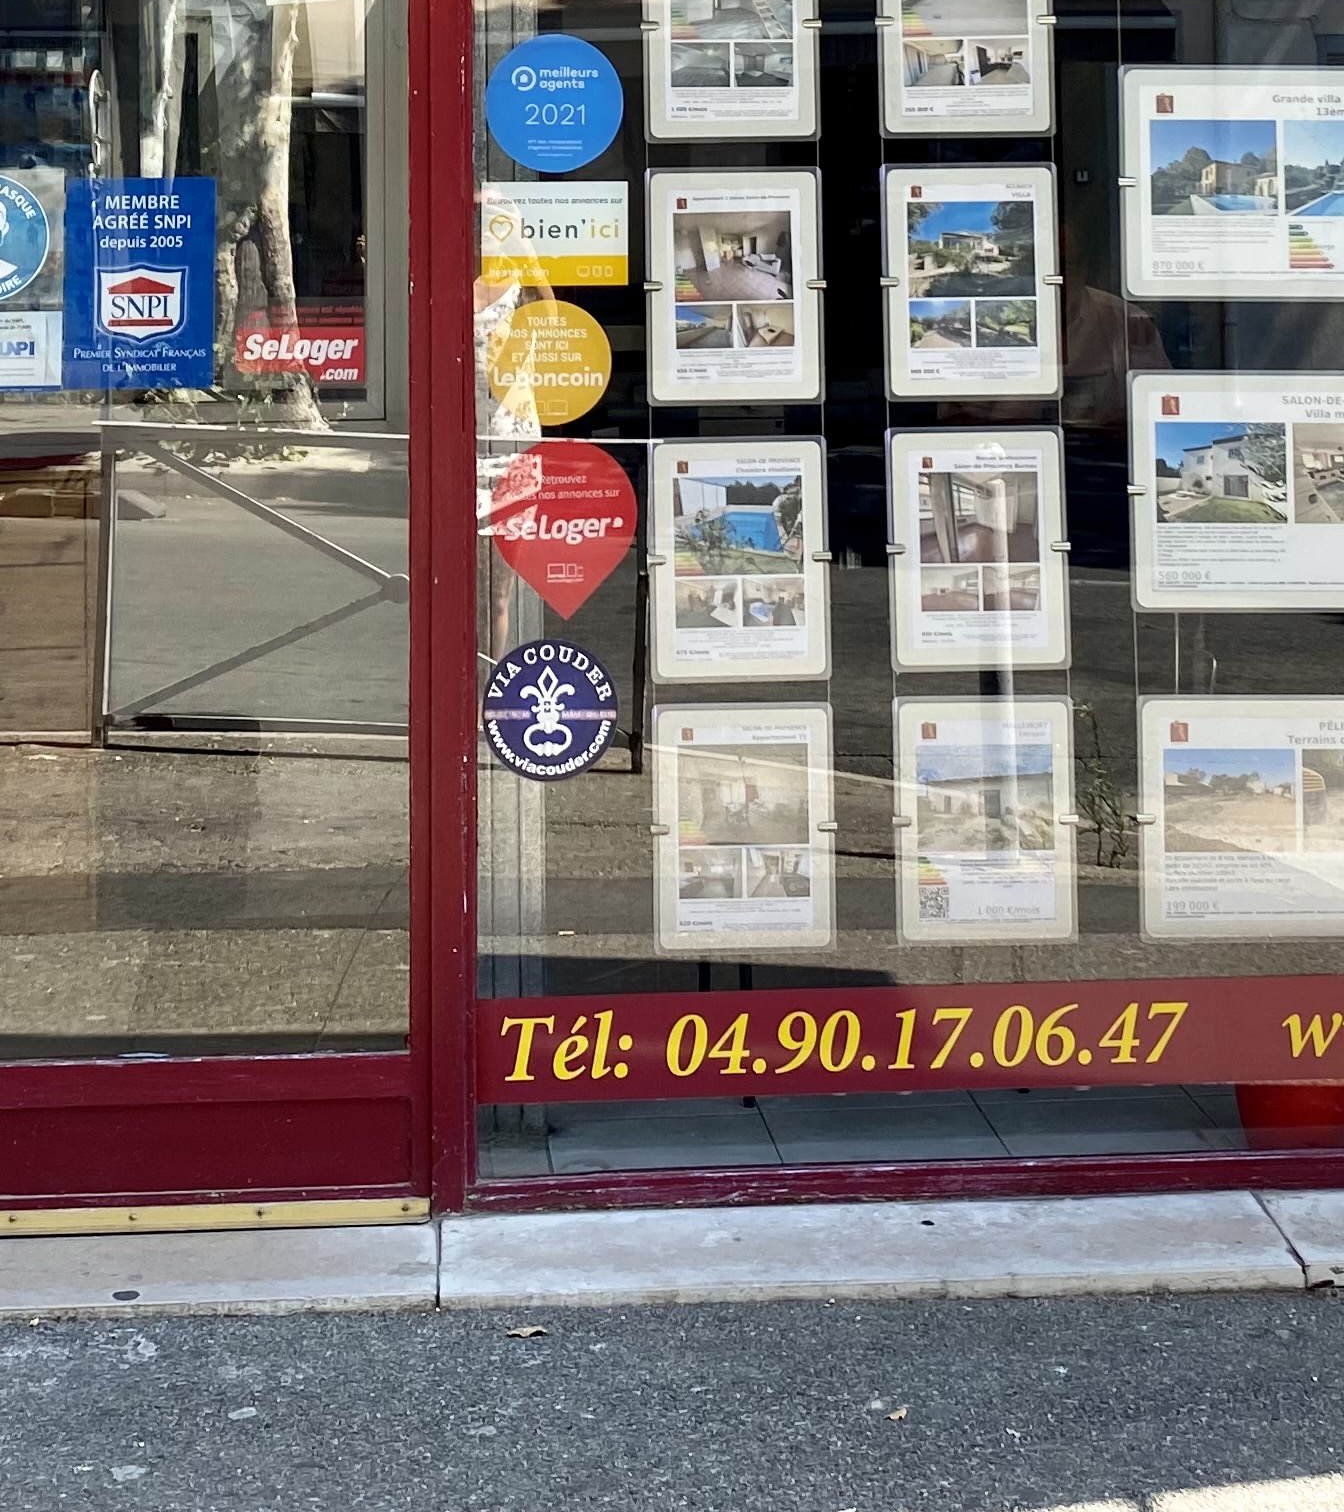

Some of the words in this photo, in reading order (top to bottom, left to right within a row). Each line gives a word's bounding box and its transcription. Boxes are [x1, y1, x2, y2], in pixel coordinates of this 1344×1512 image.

[539, 66, 599, 79] meilleurs
[539, 78, 585, 92] agents
[1272, 93, 1314, 104] Grande
[1317, 93, 1342, 104] villa
[525, 103, 586, 125] 2021
[105, 195, 180, 210] MEMBRE
[92, 210, 150, 230] AGRÉÉ
[154, 215, 191, 230] SNPI
[99, 235, 146, 251] depuis
[150, 235, 183, 249] 2005
[110, 295, 170, 321] SNPI
[527, 316, 567, 327] TOUTES
[243, 333, 359, 366] SeLoger
[524, 340, 553, 351] SONT
[555, 340, 569, 351] ICI
[511, 352, 525, 362] ET
[560, 352, 583, 362] SUR
[102, 363, 115, 372] DE
[319, 368, 359, 380] .com
[493, 365, 604, 387] leboncoin
[1305, 408, 1331, 419] Villa
[538, 490, 556, 500] nos
[557, 489, 603, 499] annonces
[604, 488, 621, 498] sur
[504, 514, 612, 545] SeLoger
[487, 661, 522, 699] VIA
[523, 644, 613, 701] COUDER
[1287, 734, 1337, 745] Terrains
[487, 719, 612, 776] www.viacouder.com
[499, 1010, 633, 1083] Tél:
[665, 1001, 1190, 1077] 04.90.17.06.47
